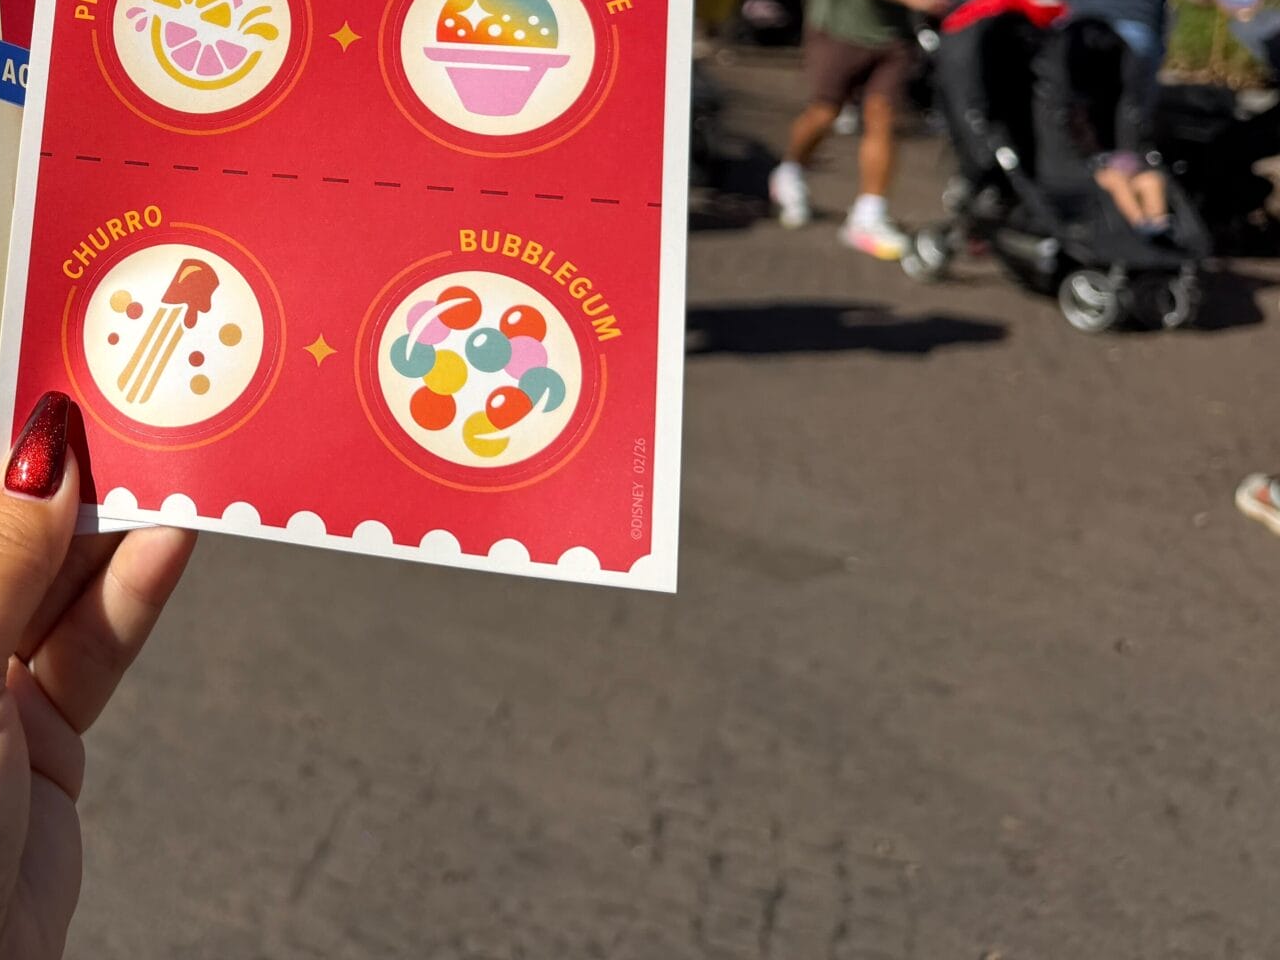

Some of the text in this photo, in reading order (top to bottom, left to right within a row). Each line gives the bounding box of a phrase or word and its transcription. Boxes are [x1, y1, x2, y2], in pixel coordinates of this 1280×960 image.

[62, 204, 164, 281] CHURRO
[459, 228, 622, 343] BUBBLEGUM
[632, 437, 646, 474] 02/26
